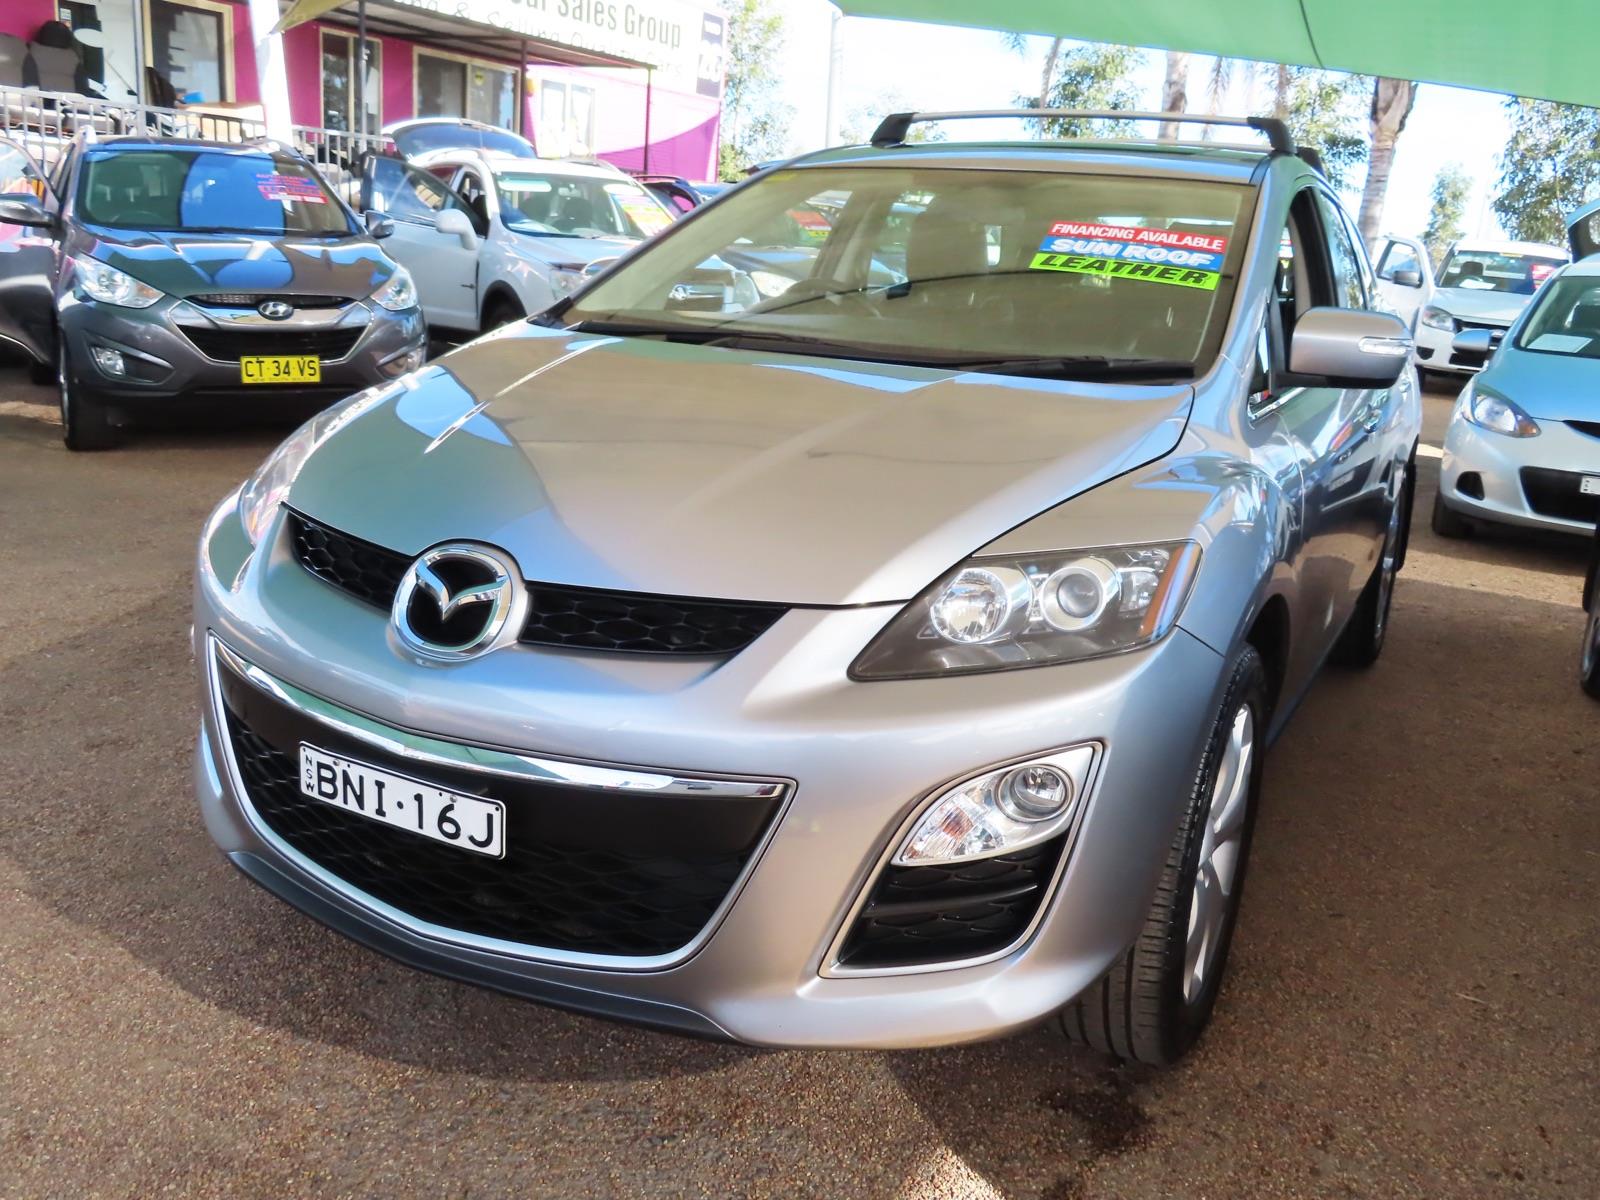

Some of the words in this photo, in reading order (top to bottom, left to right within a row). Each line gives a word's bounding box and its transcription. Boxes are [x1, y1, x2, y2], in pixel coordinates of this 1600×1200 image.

[558, 0, 616, 31] Sales
[625, 4, 680, 50] Group
[1052, 223, 1135, 240] FINANCING
[1136, 231, 1224, 250] AVAILABLE
[1050, 238, 1123, 256] SUN
[1121, 245, 1215, 267] ROOF
[1040, 254, 1209, 284] LEATHER
